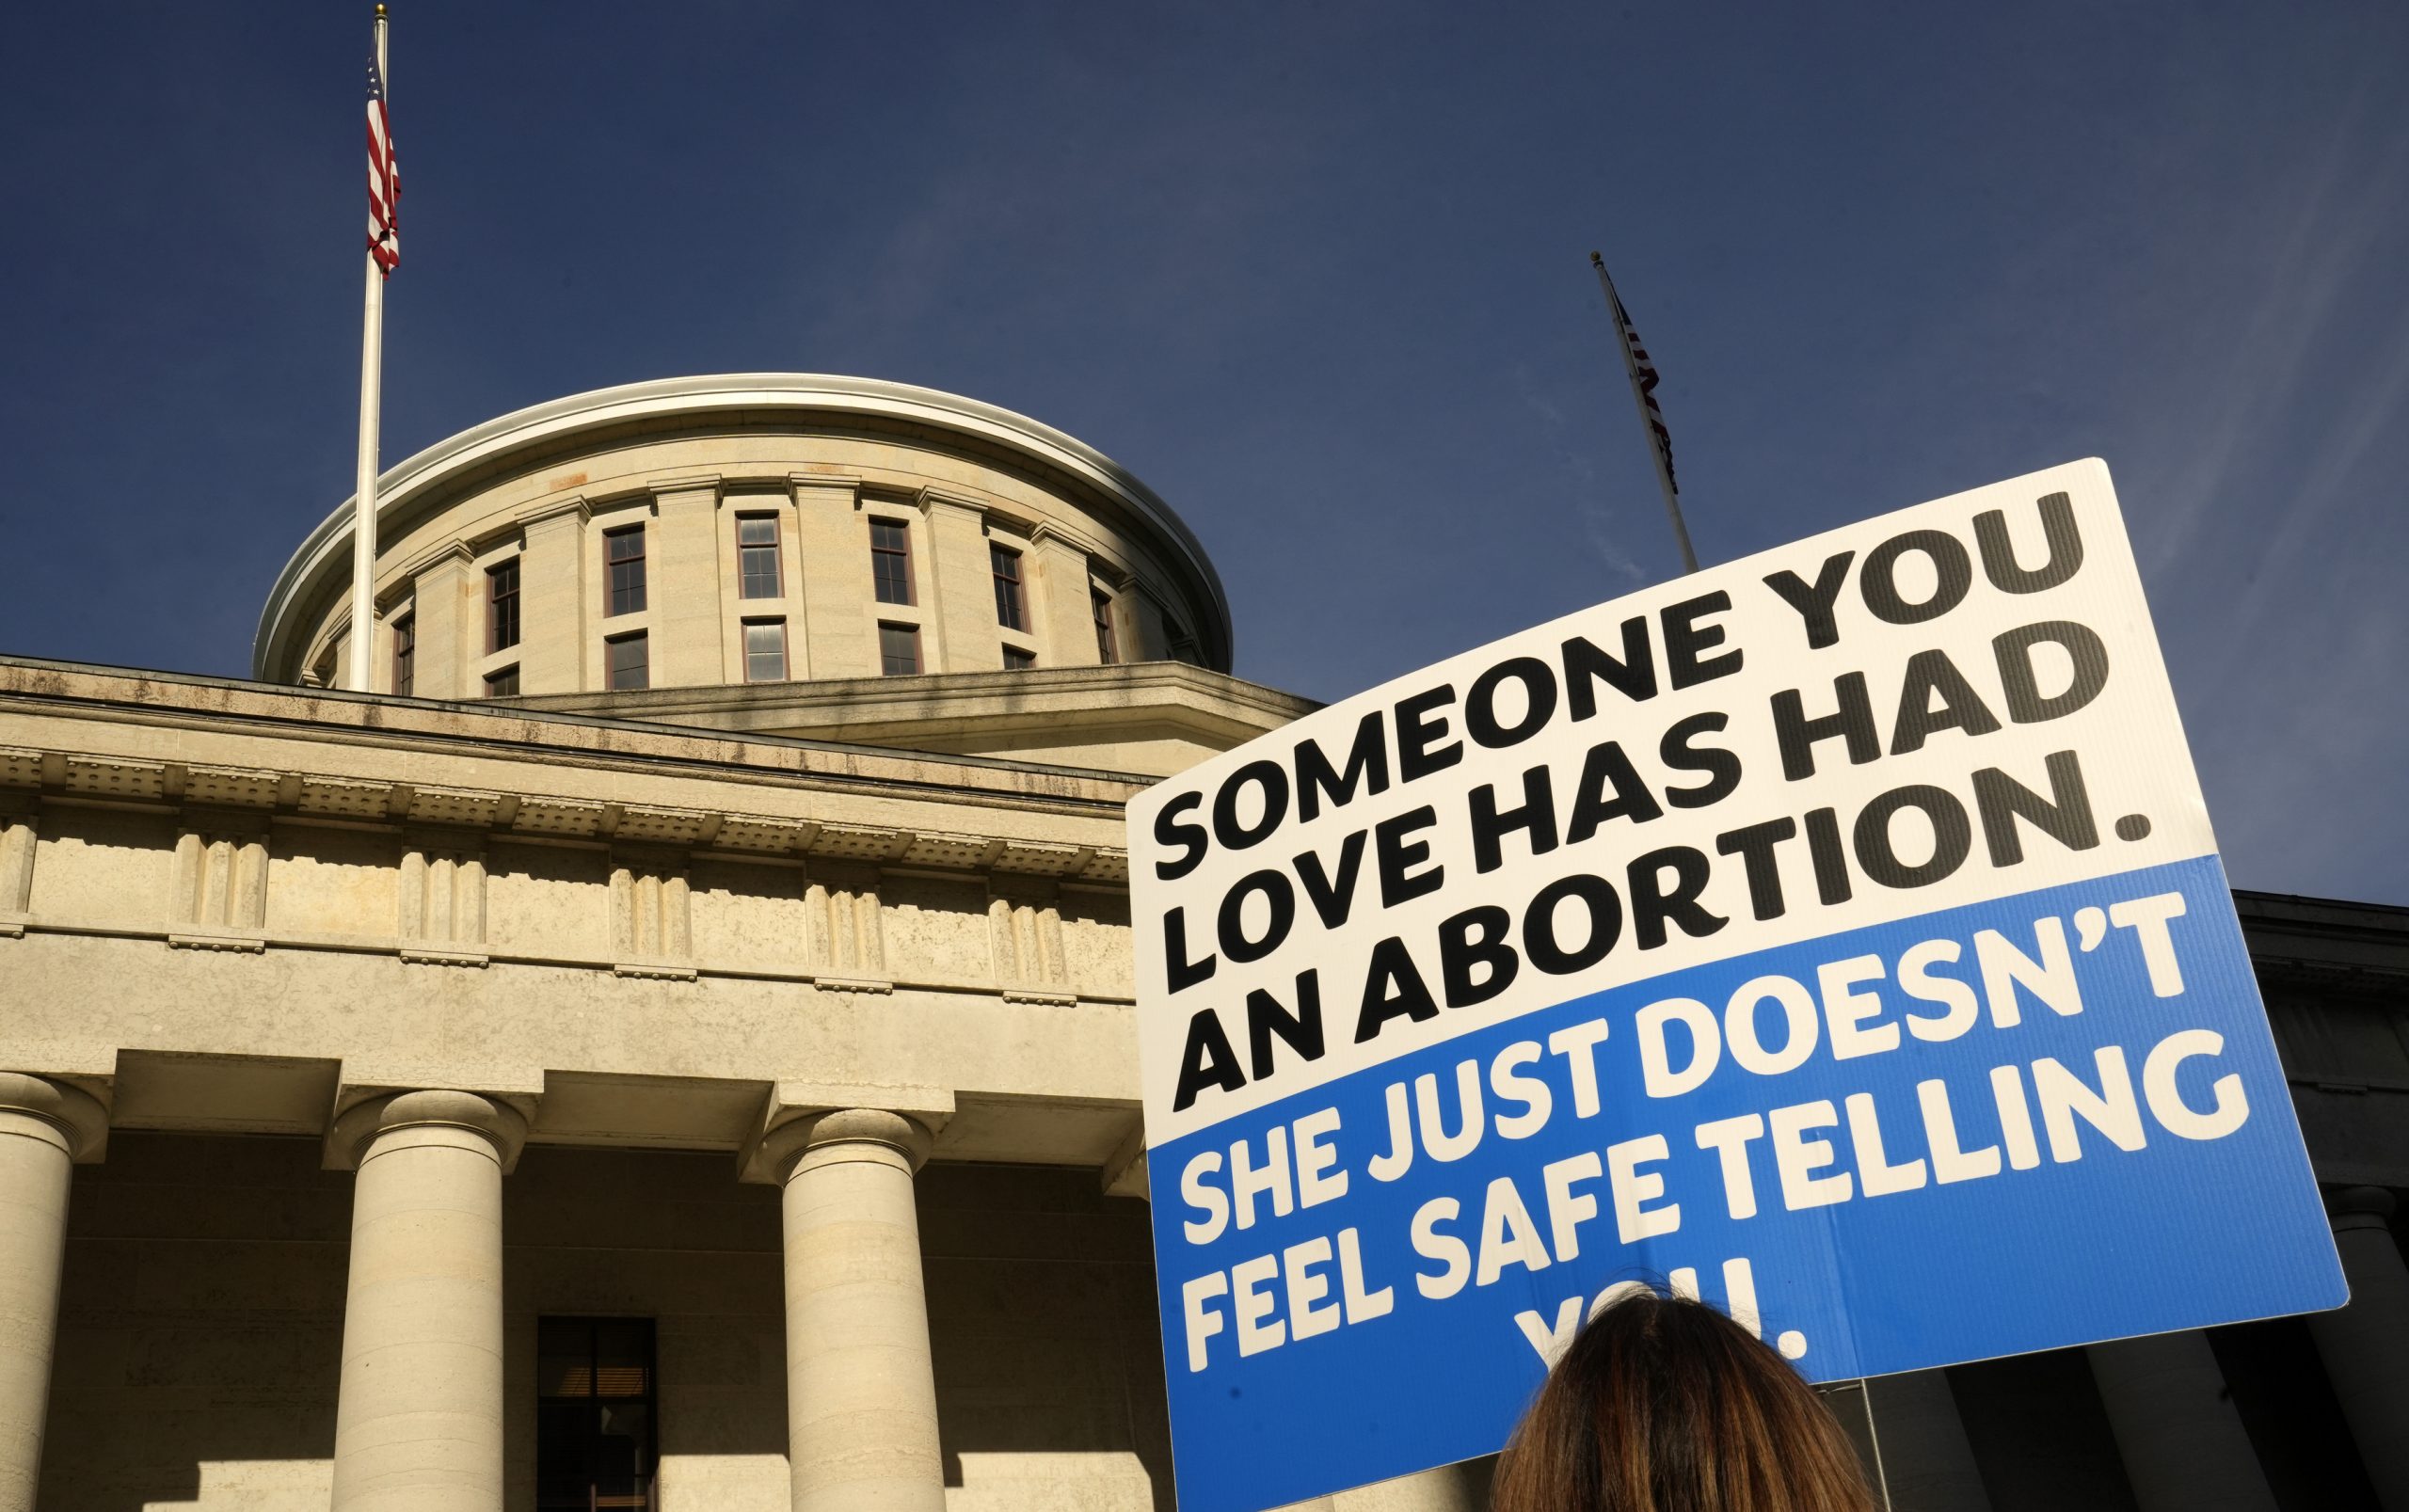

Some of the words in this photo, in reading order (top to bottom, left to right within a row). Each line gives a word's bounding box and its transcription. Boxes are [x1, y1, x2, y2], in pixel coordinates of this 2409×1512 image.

[1154, 597, 1744, 882] SOMEONE
[1765, 491, 2085, 650] YOU
[1163, 804, 1444, 995] LOVE
[1467, 711, 1743, 875] HAS
[1769, 620, 2110, 782] HAD
[1173, 967, 1326, 1113] AN
[1353, 749, 2152, 1044] ABORTION.
[1180, 1106, 1349, 1246] SHE
[1367, 1018, 1610, 1183] JUST
[1635, 890, 2189, 1099] DOESN’T
[1182, 1227, 1395, 1373] FEEL
[1410, 1133, 1682, 1300] SAFE
[1694, 1028, 2251, 1220] TELLING
[1513, 1257, 1808, 1375] YU.
